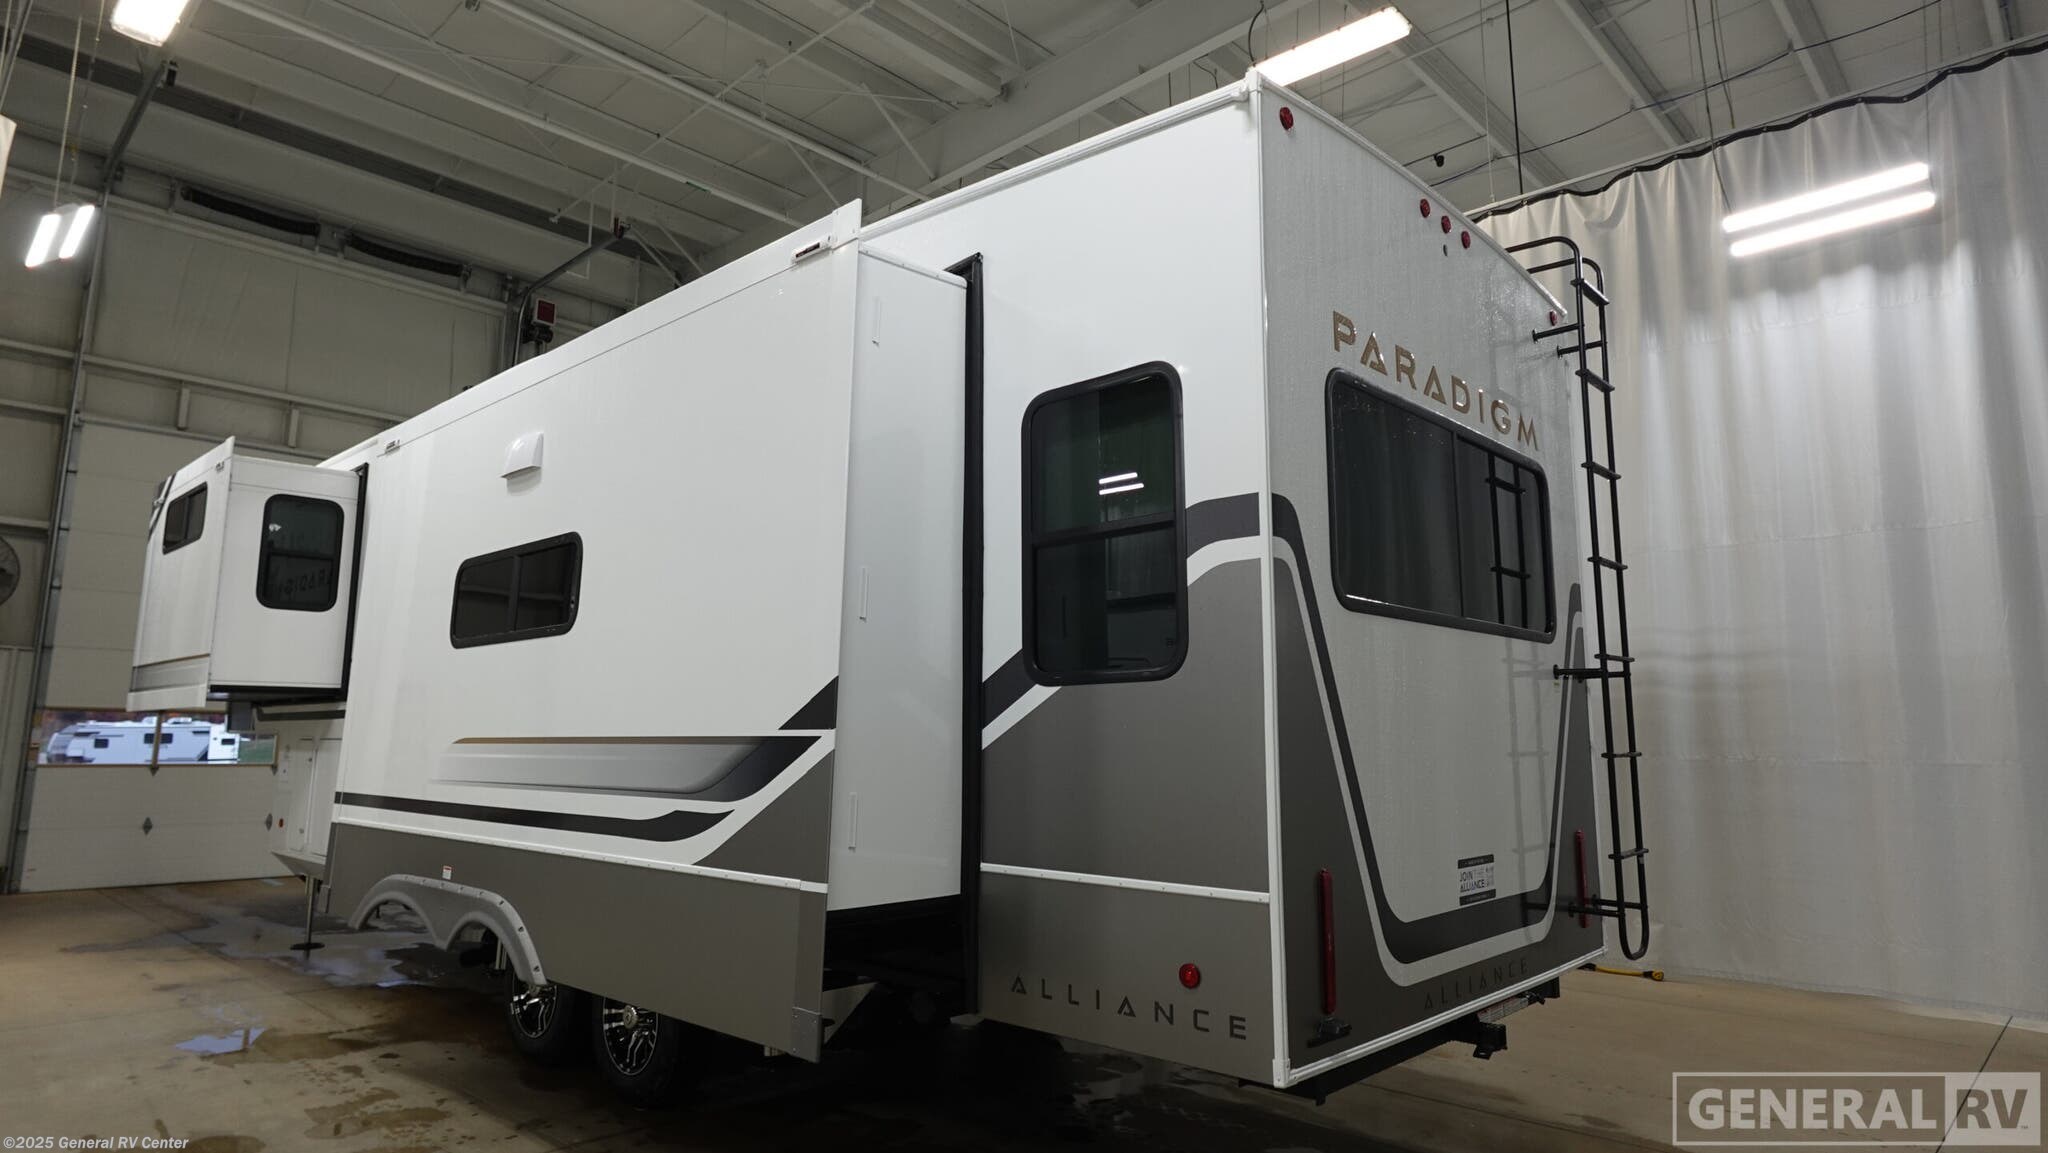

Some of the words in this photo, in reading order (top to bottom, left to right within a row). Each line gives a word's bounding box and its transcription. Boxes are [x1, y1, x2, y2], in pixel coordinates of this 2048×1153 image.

[1333, 310, 1538, 450] PARADIGM
[1011, 975, 1247, 1040] ALLIANCE
[1424, 957, 1528, 1010] ALLIANCE
